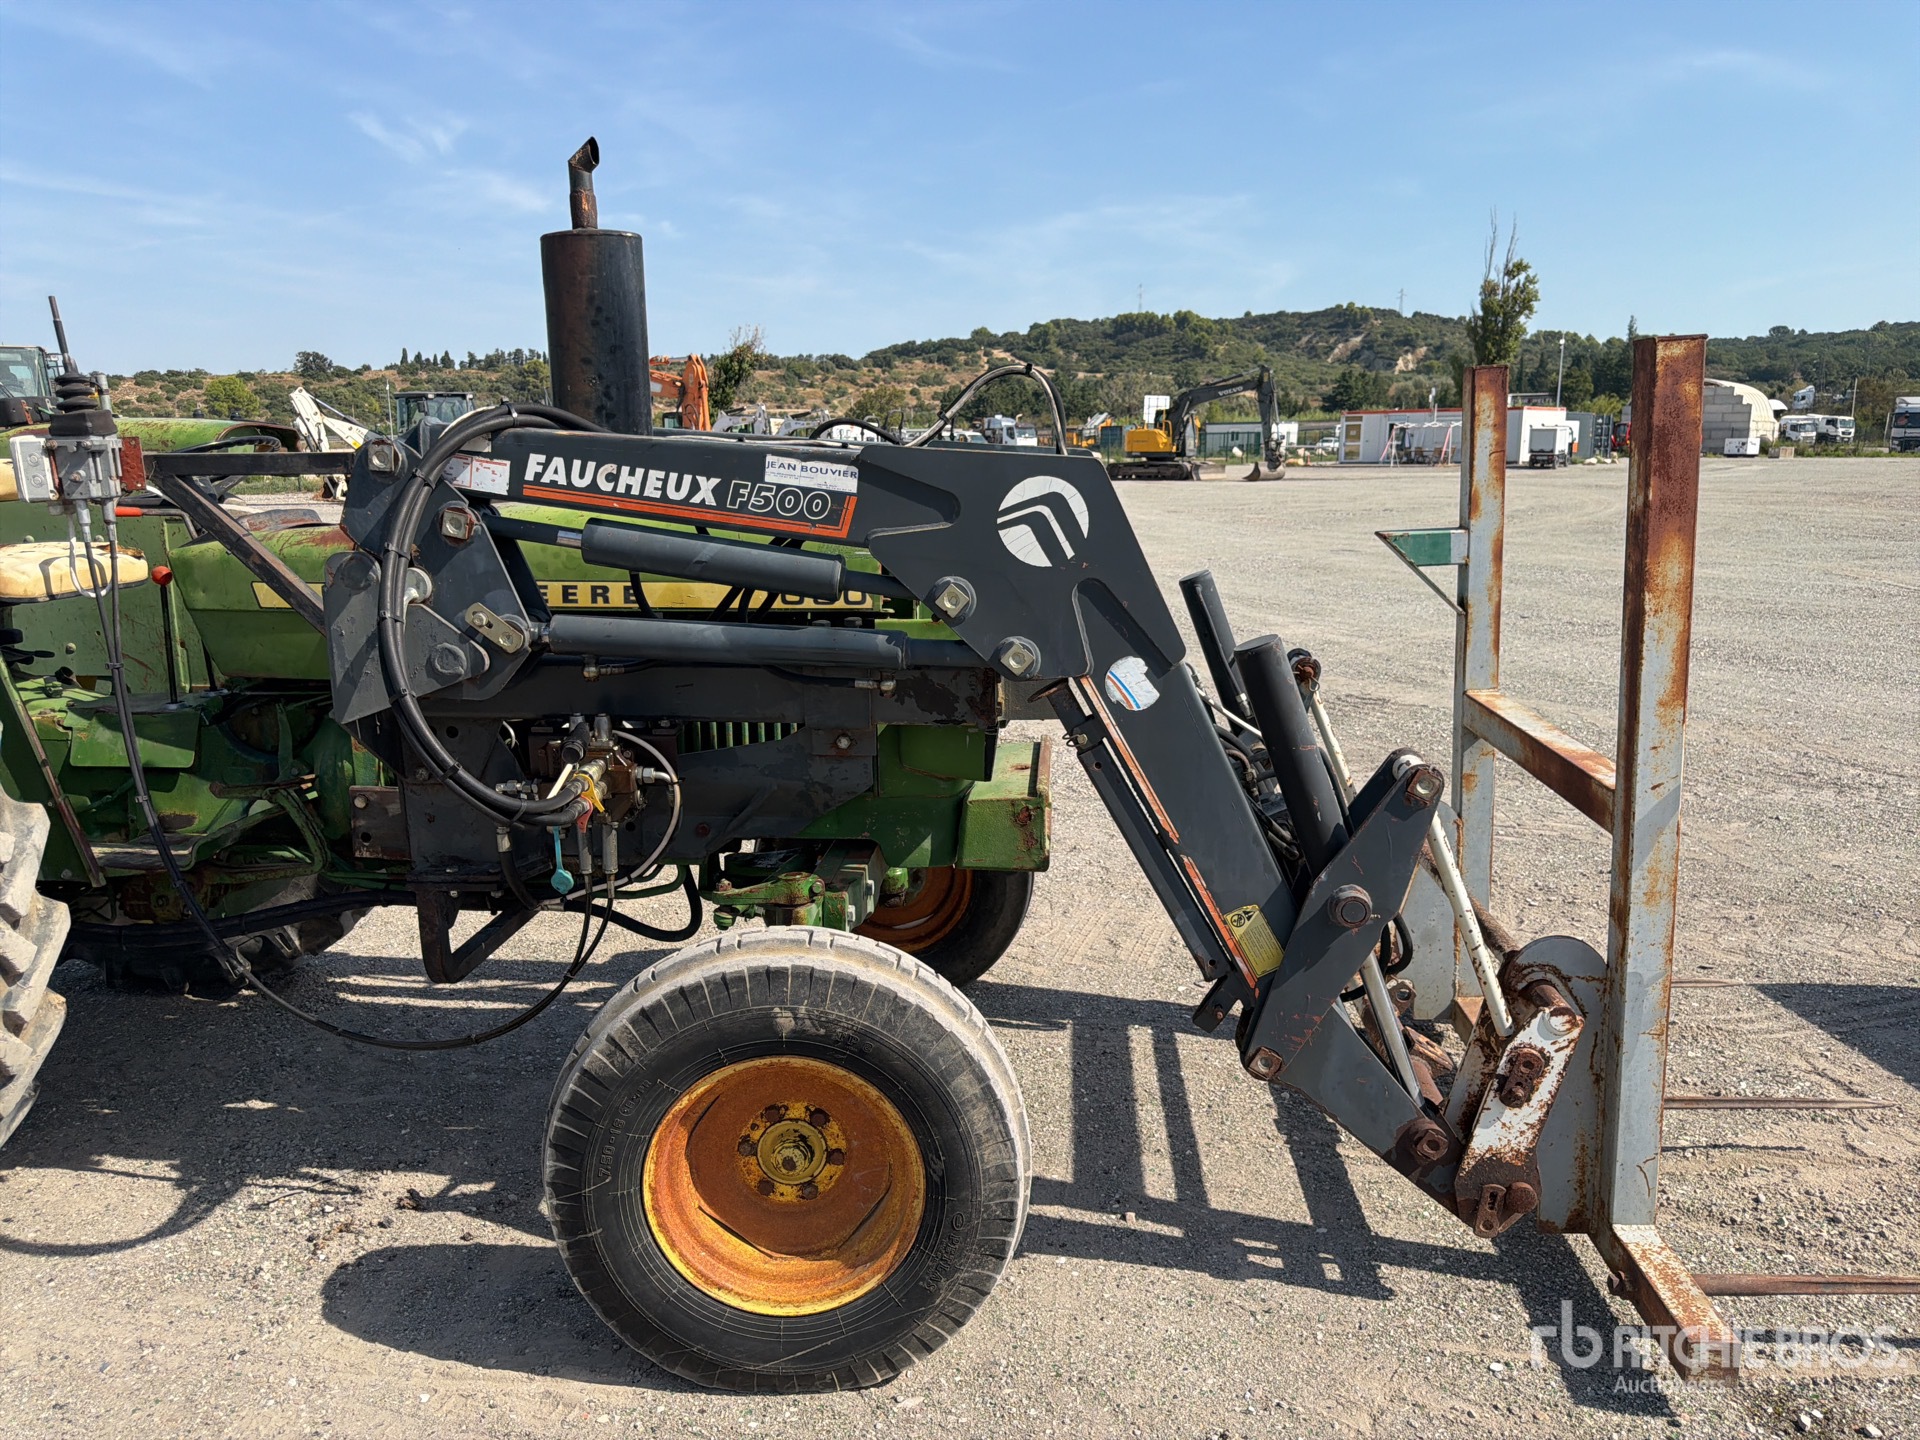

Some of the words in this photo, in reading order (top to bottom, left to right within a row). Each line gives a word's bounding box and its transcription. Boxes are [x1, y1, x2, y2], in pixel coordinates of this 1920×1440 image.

[1218, 386, 1243, 396] VOLVO
[762, 461, 796, 471] JEAN
[801, 465, 858, 478] BOUVIER
[524, 453, 721, 506] FAUCHEUX
[726, 480, 831, 520] F500
